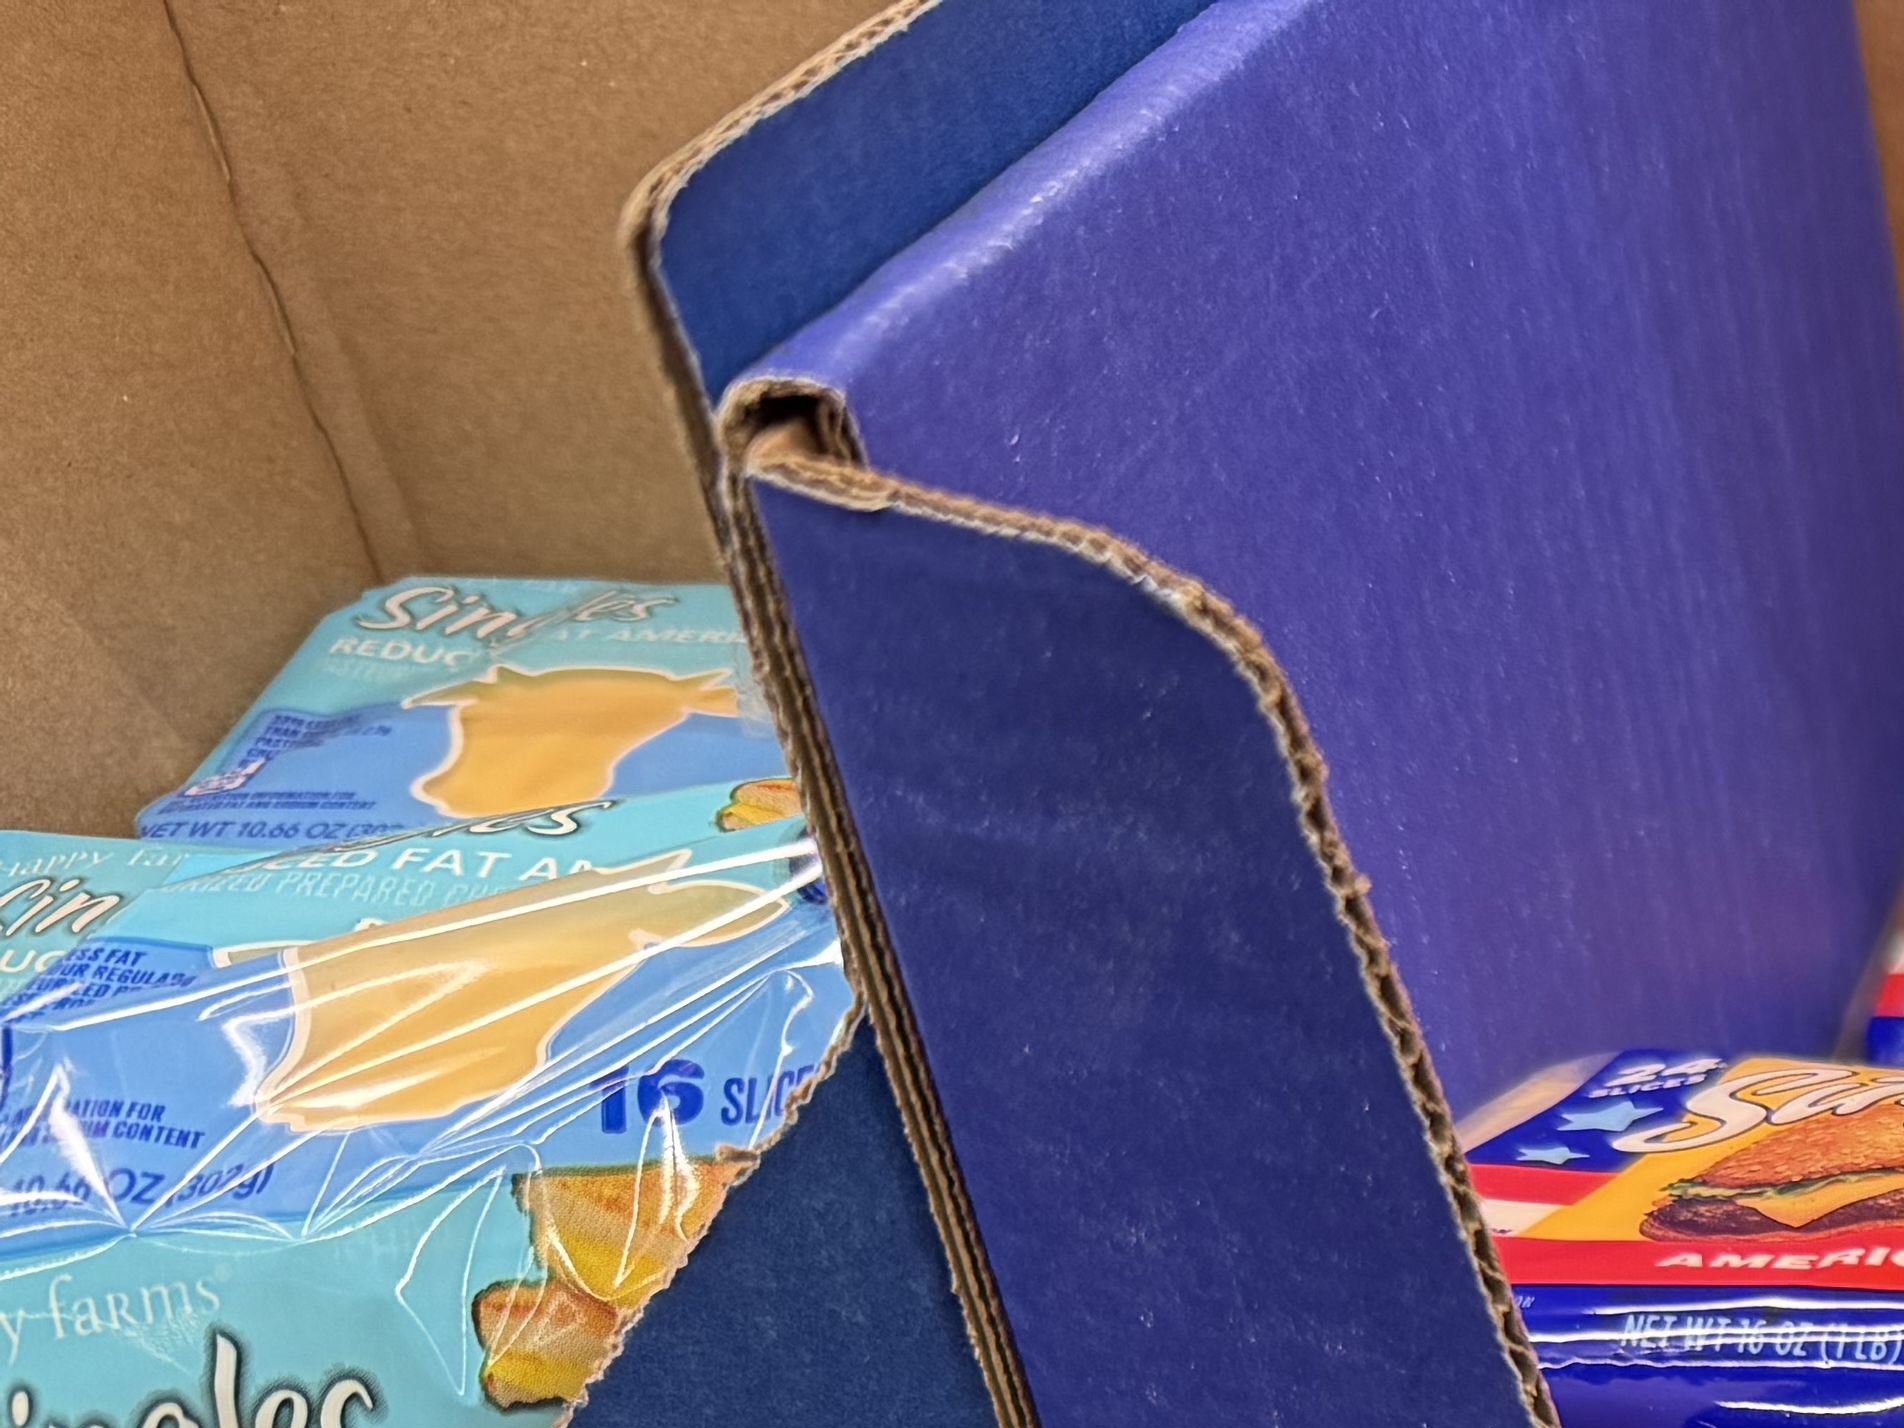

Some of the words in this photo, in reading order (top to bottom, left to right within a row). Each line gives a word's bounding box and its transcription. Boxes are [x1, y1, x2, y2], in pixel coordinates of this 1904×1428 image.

[190, 821, 237, 838] WT
[238, 821, 301, 838] 10.66
[305, 823, 347, 838] OZ
[393, 848, 512, 878] FAT
[104, 949, 147, 967] FAT
[1589, 1073, 1707, 1099] SLICES
[1605, 1057, 1727, 1087] 24
[588, 1059, 705, 1134] 16
[125, 1101, 167, 1123] FOR
[113, 1121, 205, 1149] CONTENT
[109, 1167, 166, 1205] OZ
[1623, 1313, 1678, 1350] NET
[1685, 1316, 1727, 1352] WT
[1737, 1318, 1766, 1354] 16
[1775, 1320, 1813, 1358] OZ
